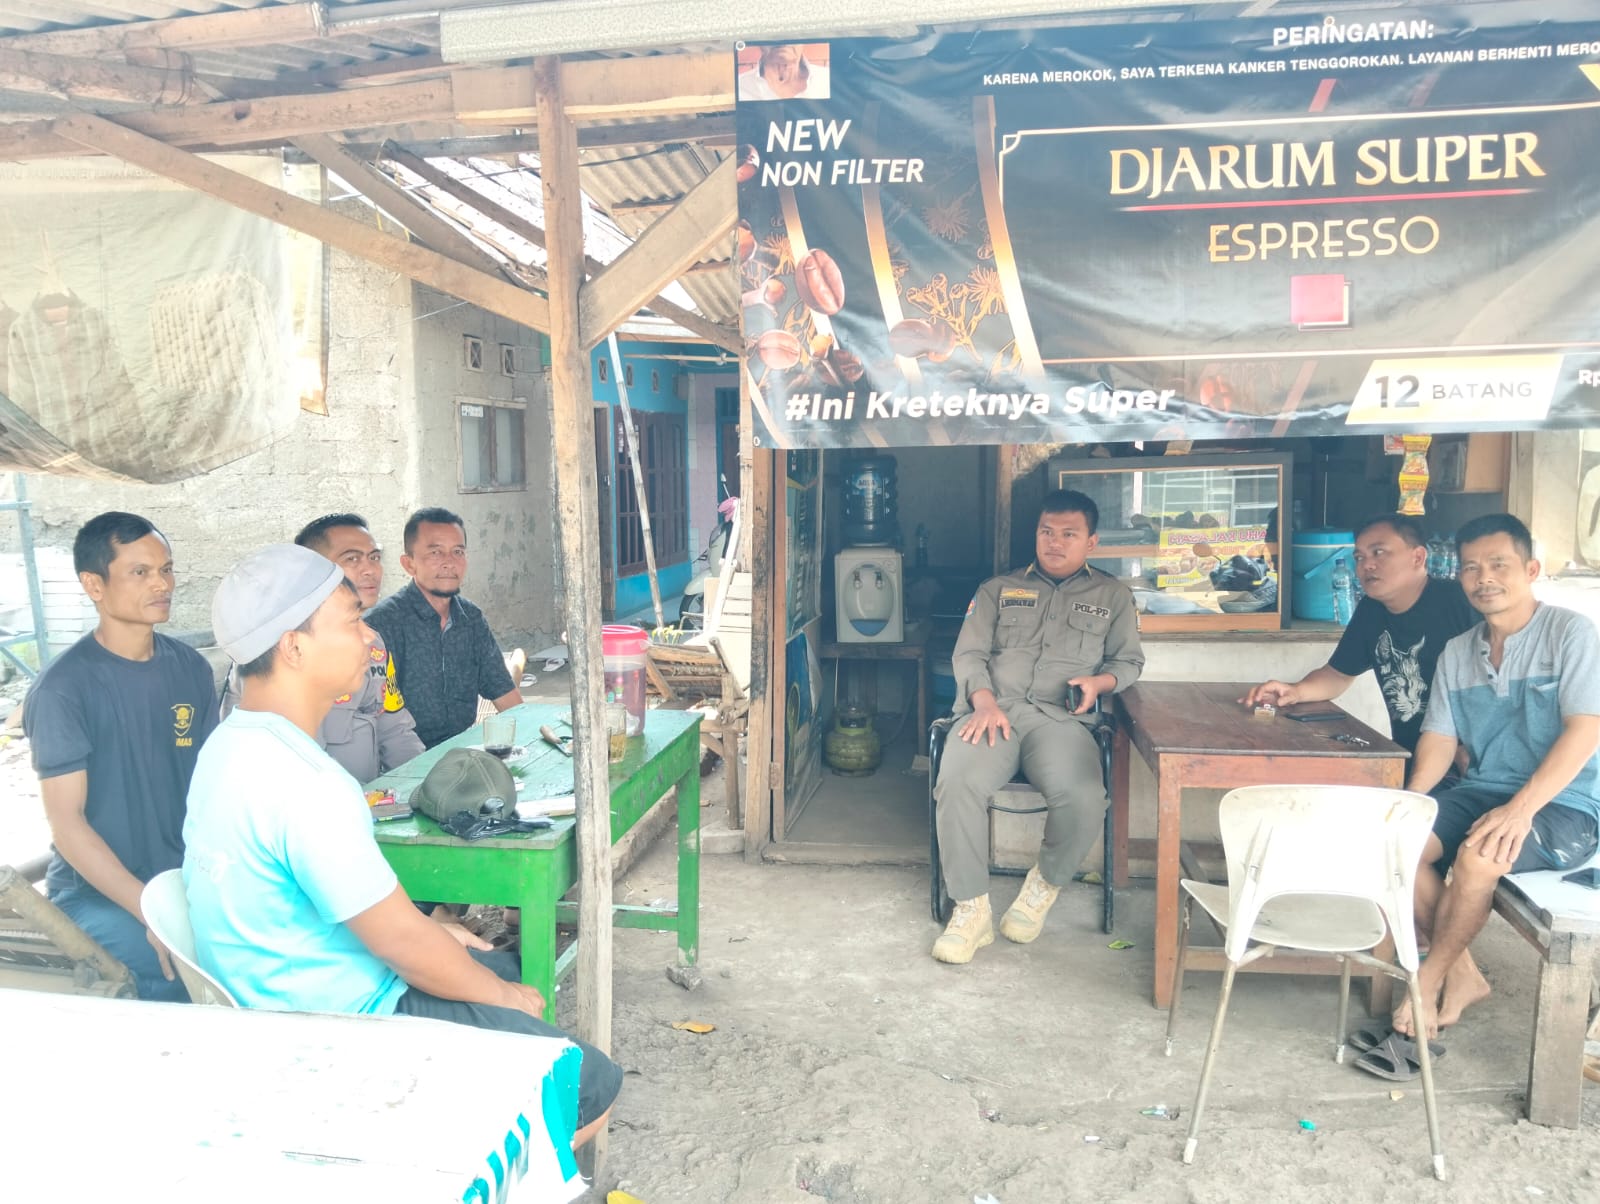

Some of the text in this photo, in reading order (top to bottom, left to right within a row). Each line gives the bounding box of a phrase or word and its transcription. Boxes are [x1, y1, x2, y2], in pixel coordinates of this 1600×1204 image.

[1272, 20, 1434, 46] PERINGATAN:
[983, 41, 1600, 86] KARENA MEROKOK, SAYA TERKENA KANKER TENGGOROKAN. LAYANAN BERHENTI MERO
[766, 118, 852, 153] NEW
[761, 158, 925, 187] NON FILTER
[1108, 132, 1547, 199] DJARUM SUPER
[1208, 216, 1441, 263] ESPRESSO
[785, 386, 1176, 421] #Ini Kreteknya Super
[1374, 374, 1533, 408] 12 BATANG
[1074, 602, 1108, 617] POL-PP
